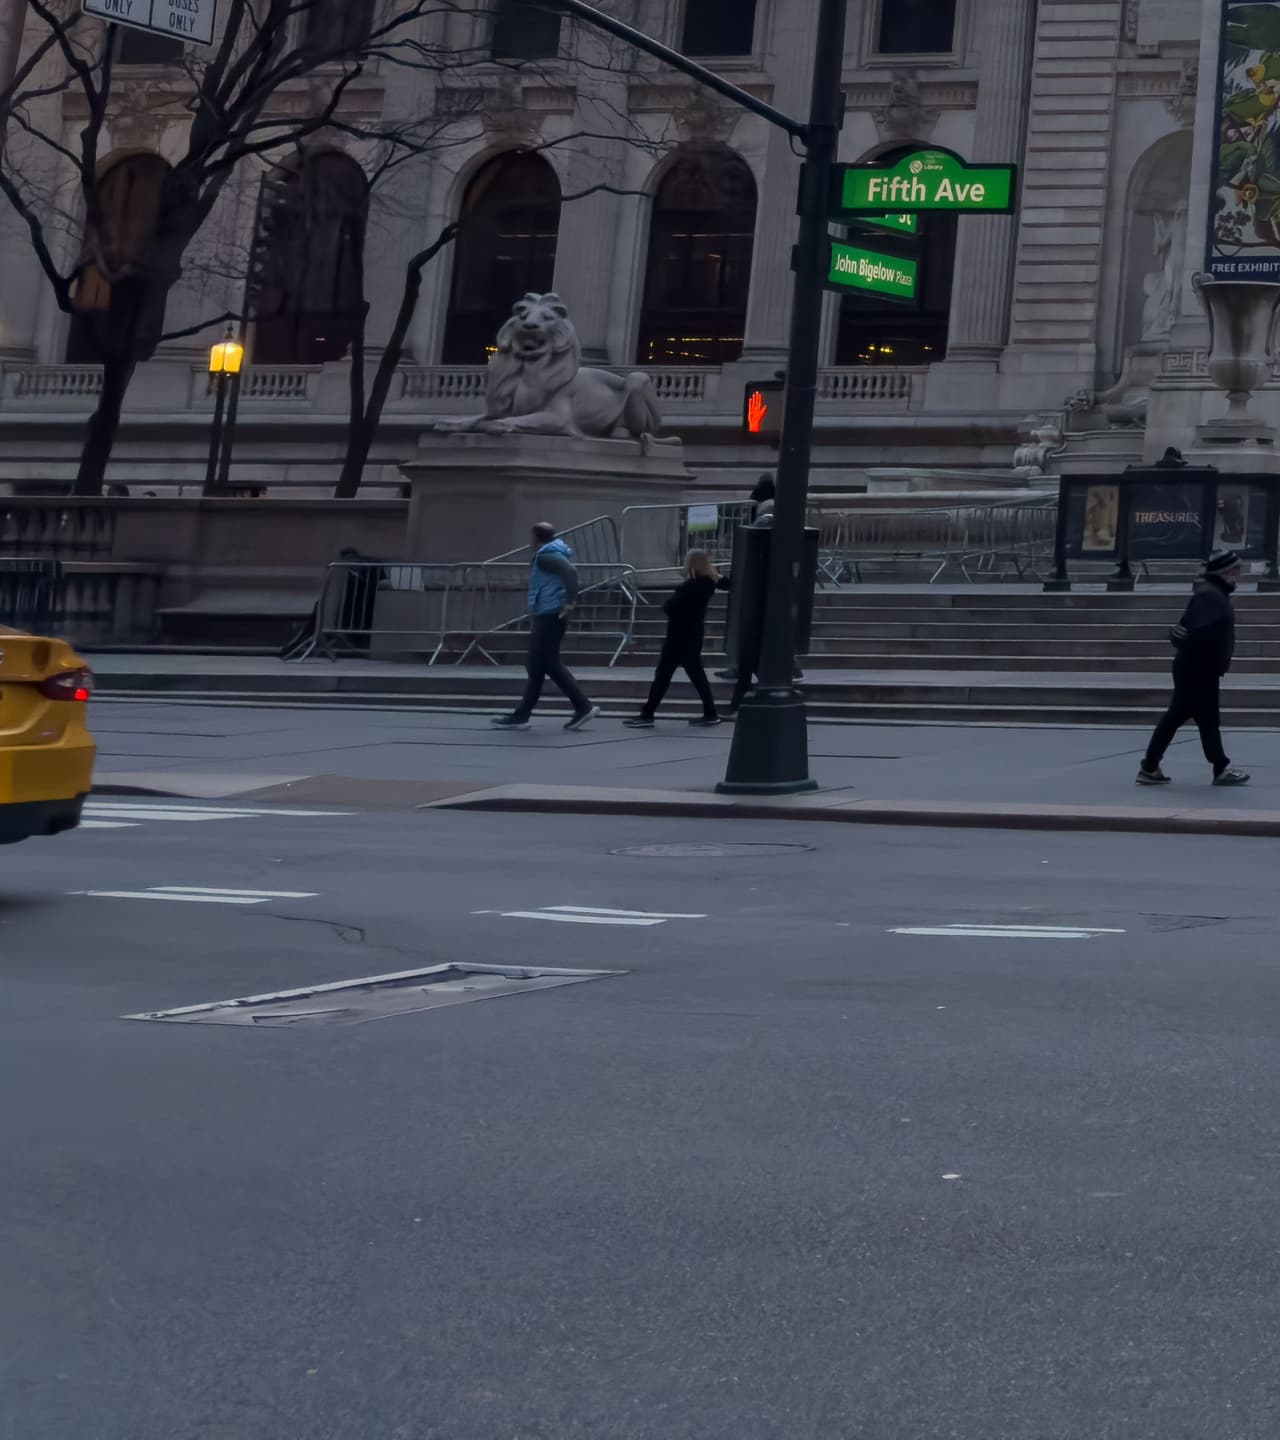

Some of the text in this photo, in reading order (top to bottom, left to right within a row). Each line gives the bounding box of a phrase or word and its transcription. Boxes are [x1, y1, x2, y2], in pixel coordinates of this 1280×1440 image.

[169, 12, 195, 33] ONLY
[867, 176, 985, 202] Fifth Ave
[835, 253, 857, 274] John
[858, 258, 896, 282] Bigelow
[1211, 263, 1236, 273] FREE
[1135, 511, 1201, 528] TREASURES
